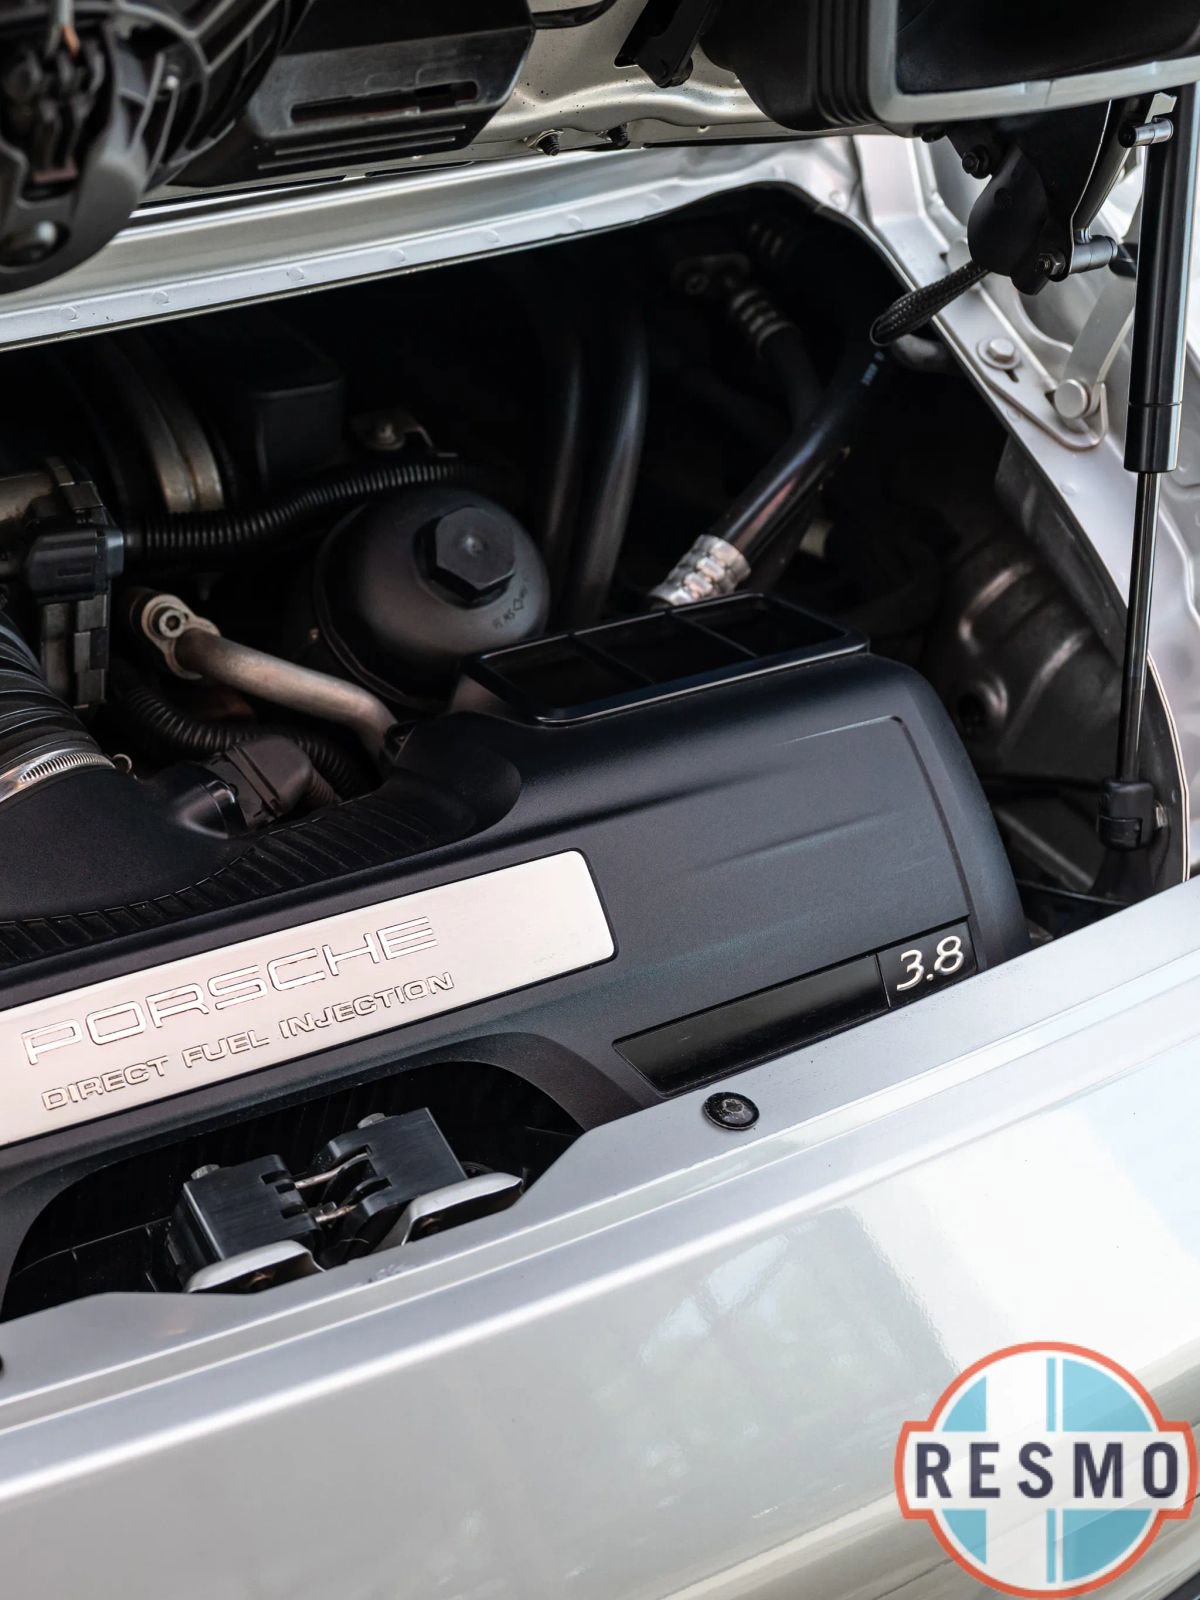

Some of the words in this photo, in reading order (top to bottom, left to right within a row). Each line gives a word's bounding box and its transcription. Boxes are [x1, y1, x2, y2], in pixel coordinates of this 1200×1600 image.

[21, 916, 438, 1065] PORSCHE
[897, 935, 964, 991] 3.8
[41, 1055, 168, 1110] DIRECT
[182, 1030, 270, 1067] FUEL
[279, 972, 454, 1038] INJECTION
